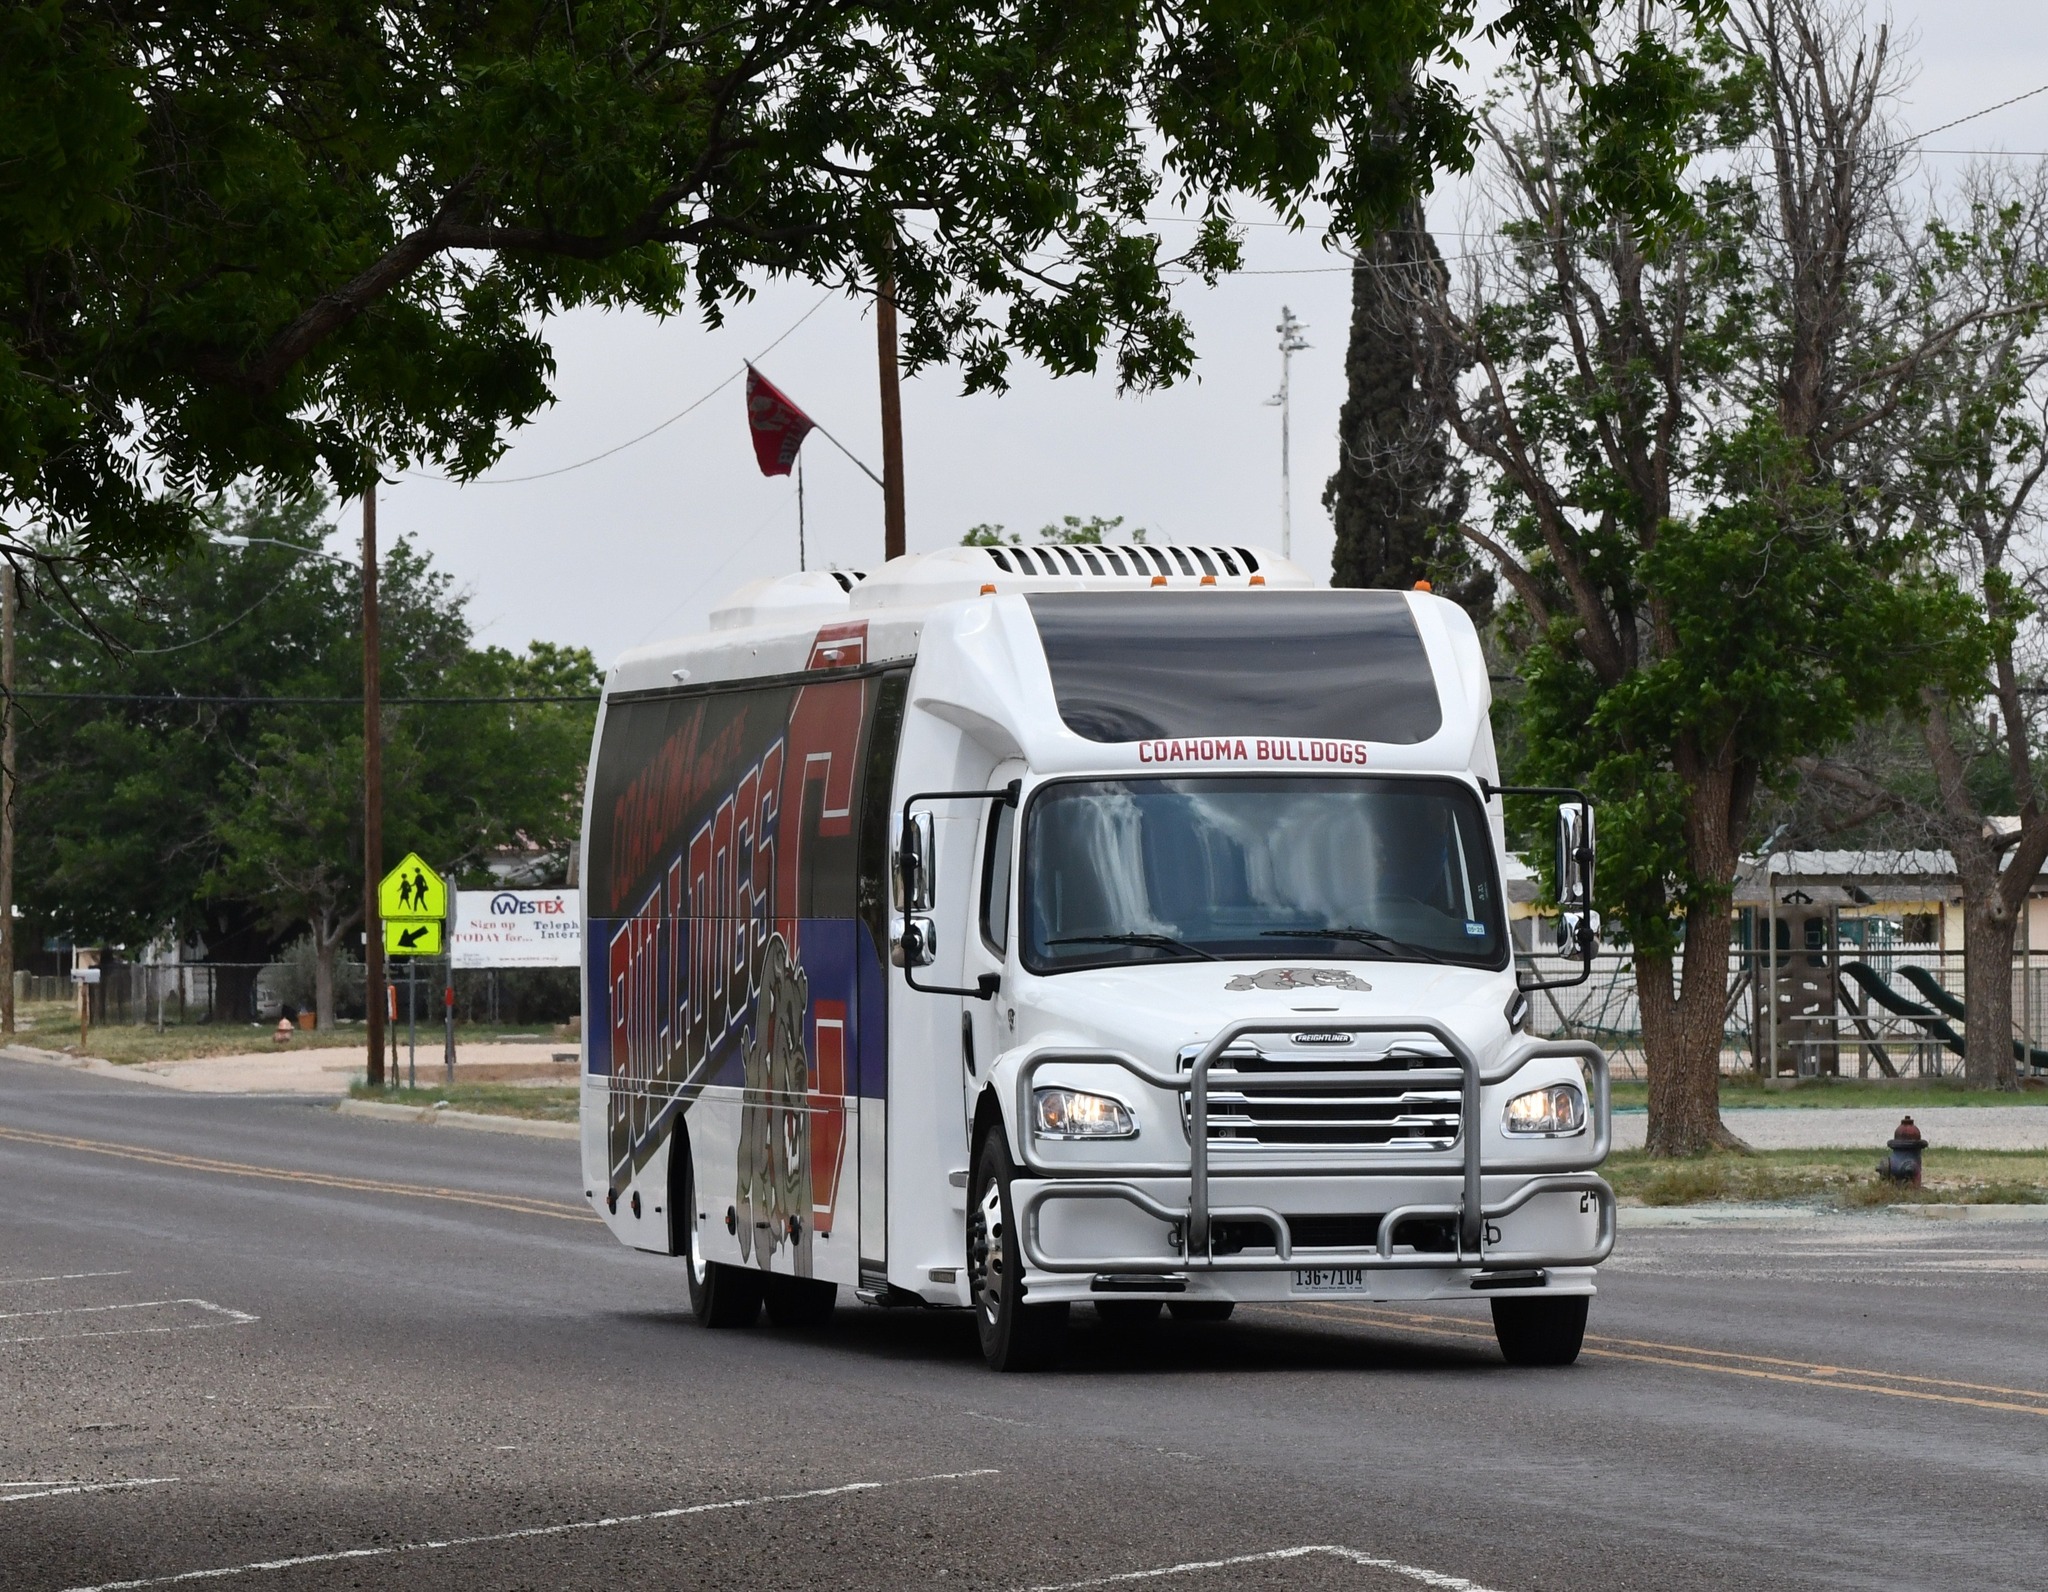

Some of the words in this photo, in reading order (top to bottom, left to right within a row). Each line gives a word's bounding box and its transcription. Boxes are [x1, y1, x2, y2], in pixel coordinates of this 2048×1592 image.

[1139, 740, 1248, 762] COAHOMA
[1257, 740, 1367, 765] BULLDOGS
[470, 920, 496, 930] Sign
[501, 922, 515, 930] up
[533, 921, 579, 931] Teleph
[455, 934, 500, 942] TODAY
[609, 737, 784, 1177] BULLDOGS
[1297, 1034, 1349, 1042] FREIGHTLINER
